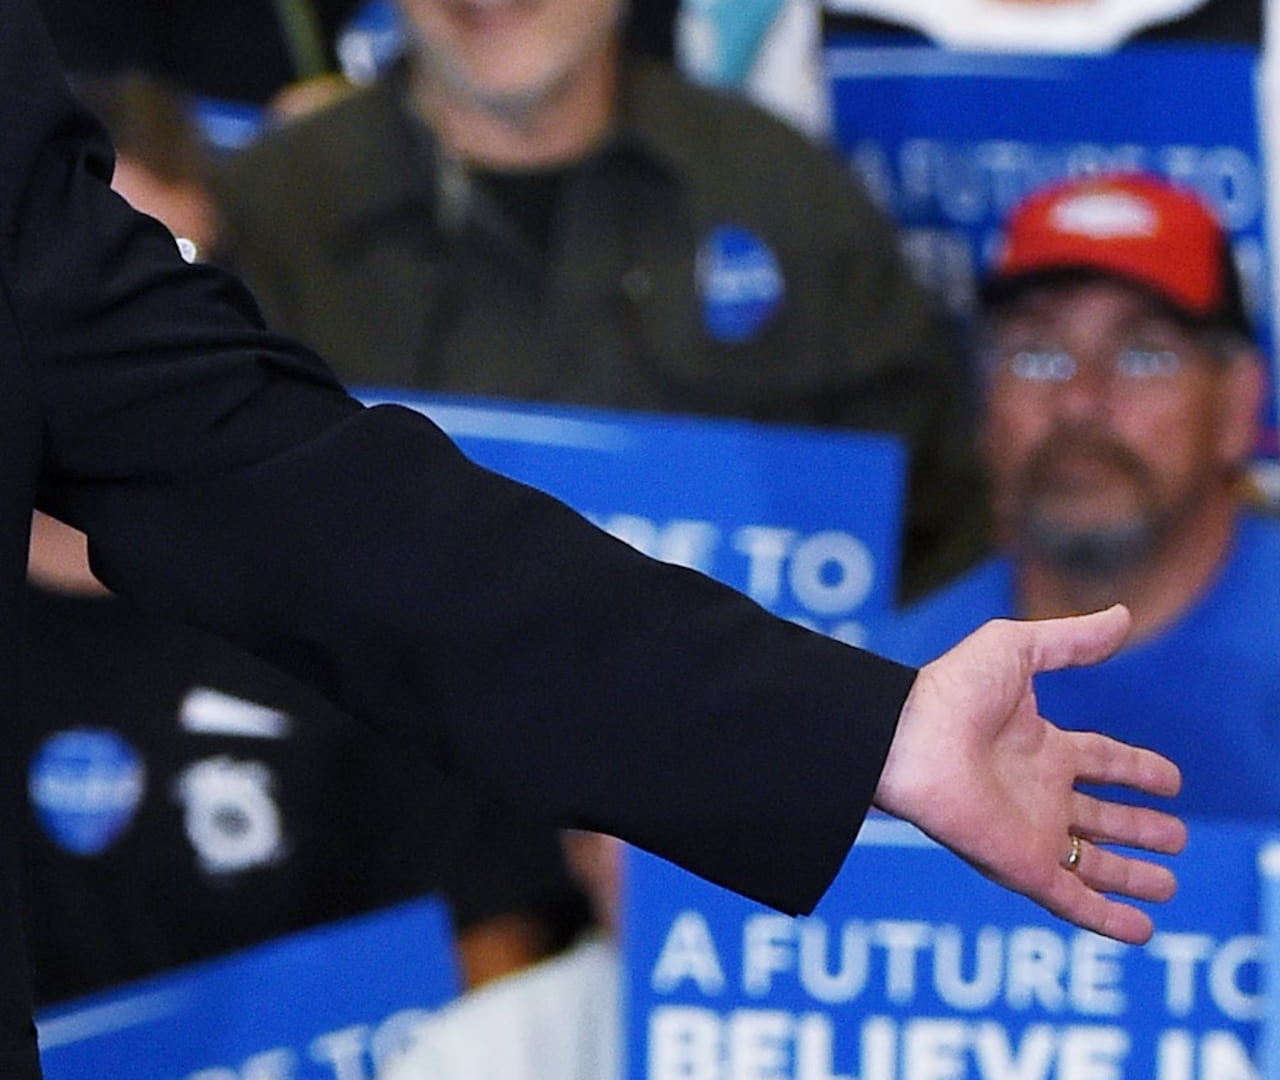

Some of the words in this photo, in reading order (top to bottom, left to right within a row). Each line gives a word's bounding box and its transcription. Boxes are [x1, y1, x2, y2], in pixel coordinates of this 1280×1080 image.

[733, 523, 876, 616] TO
[650, 909, 727, 998] A
[742, 913, 1130, 1018] FUTURE
[646, 1000, 1130, 1080] BELIEVE
